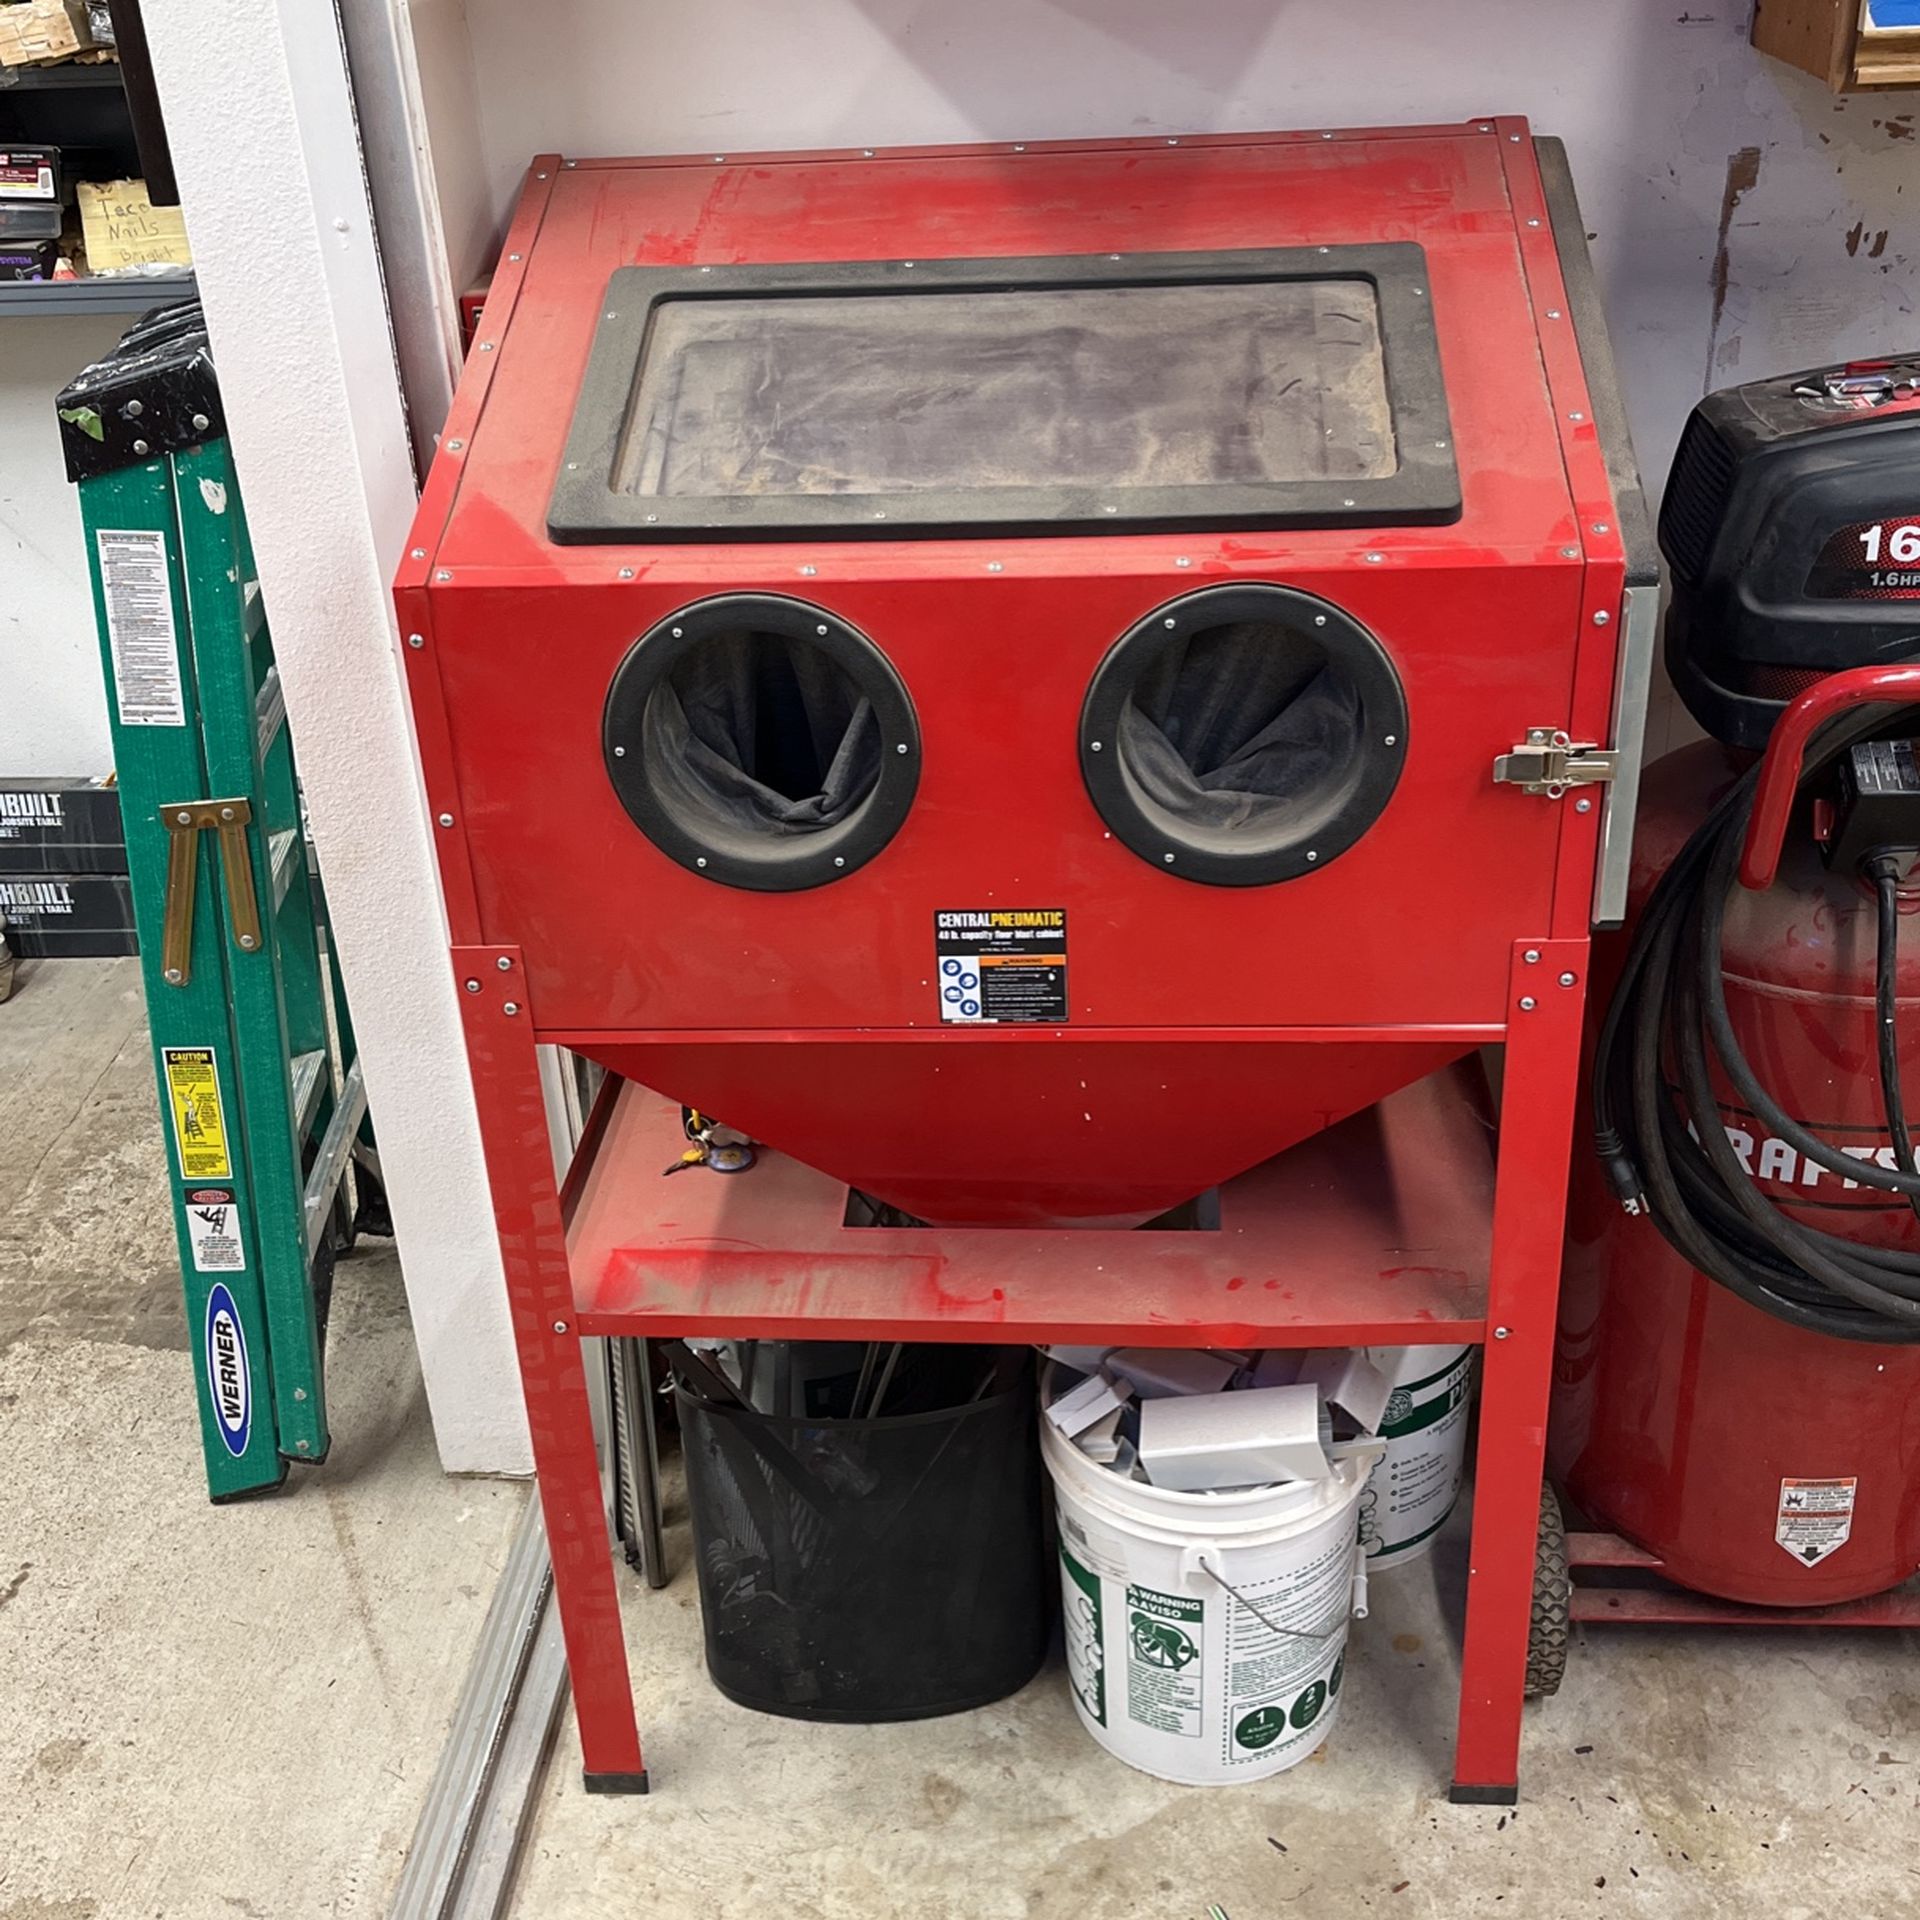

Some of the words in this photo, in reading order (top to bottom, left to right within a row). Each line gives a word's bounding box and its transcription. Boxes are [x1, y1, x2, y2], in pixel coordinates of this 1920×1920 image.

[109, 216, 159, 240] Nails
[170, 1053, 209, 1061] CAUTION
[216, 1319, 242, 1420] WERNER
[1139, 1588, 1201, 1611] WARNING
[1139, 1602, 1182, 1618] AVISO
[1305, 1686, 1316, 1703] 2
[1256, 1710, 1265, 1724] 1
